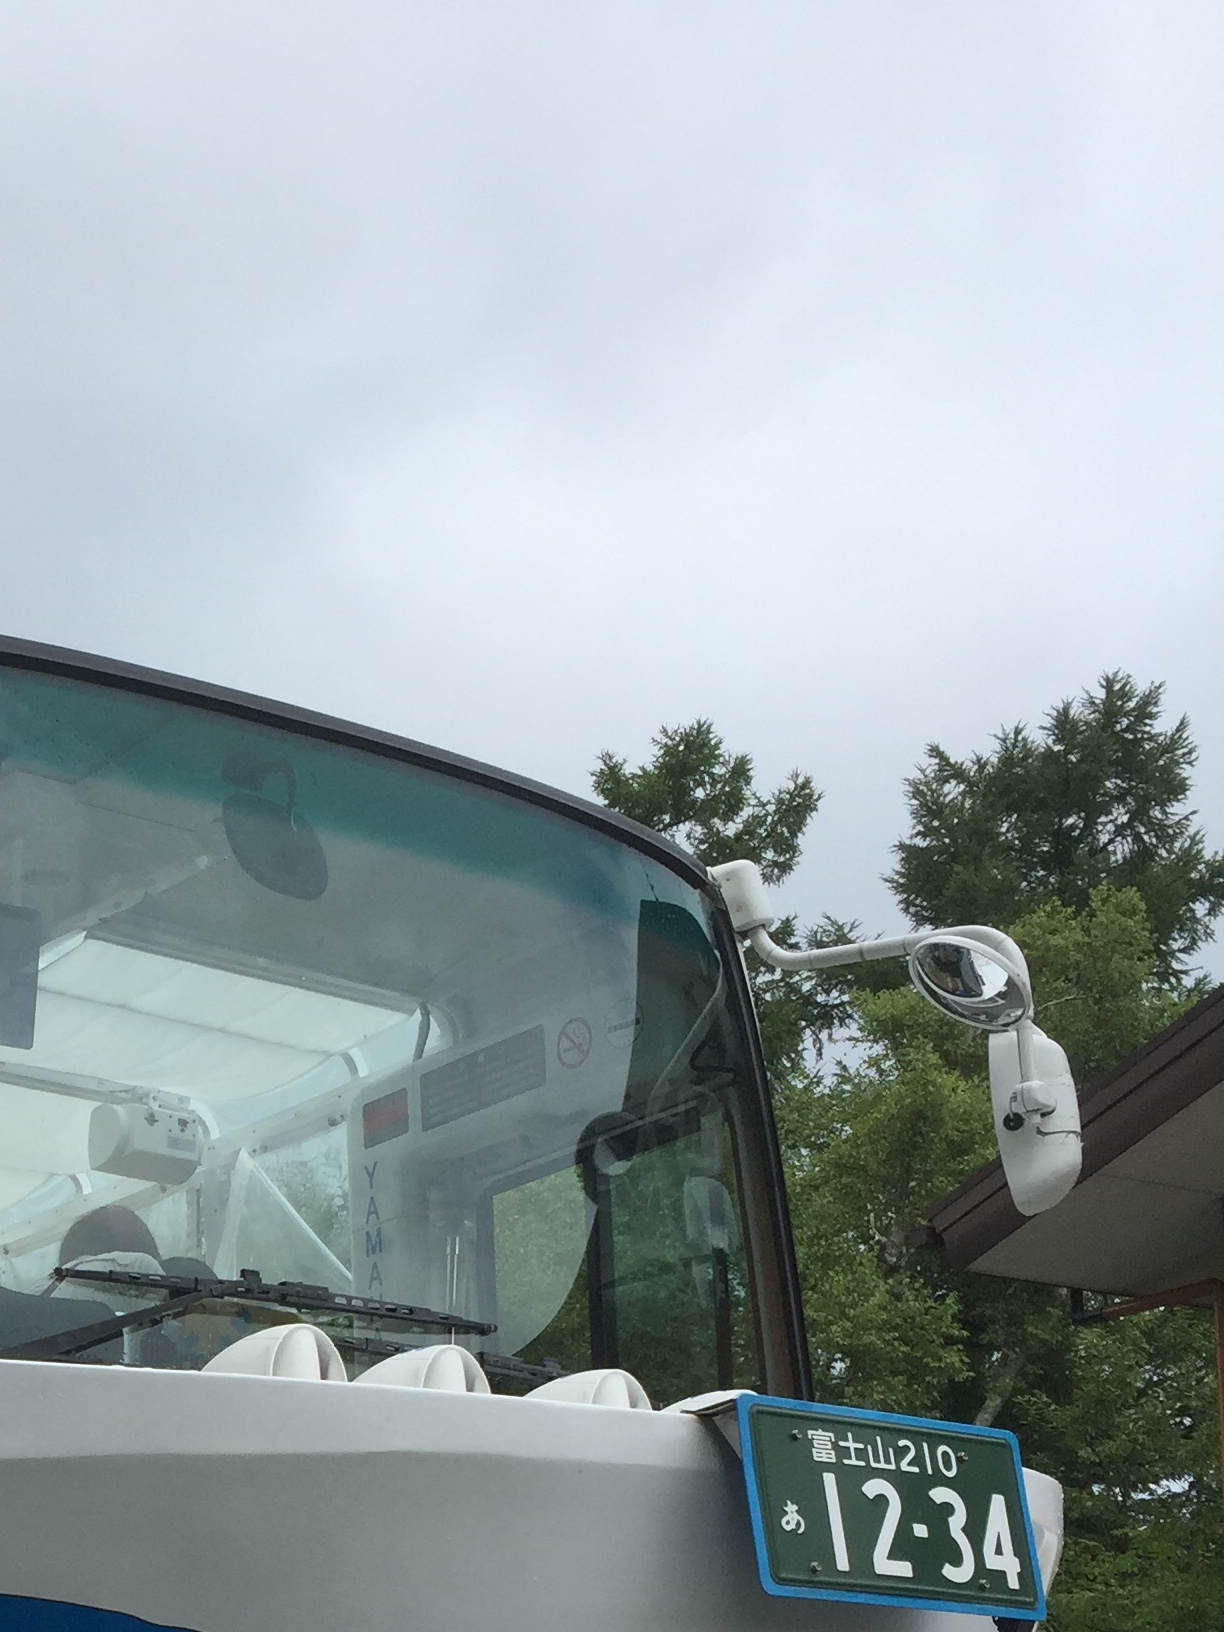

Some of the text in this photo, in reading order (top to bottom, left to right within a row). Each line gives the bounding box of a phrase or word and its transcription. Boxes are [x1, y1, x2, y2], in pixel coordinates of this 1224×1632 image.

[806, 1428, 958, 1478] 富士山210
[780, 1500, 805, 1534] あ
